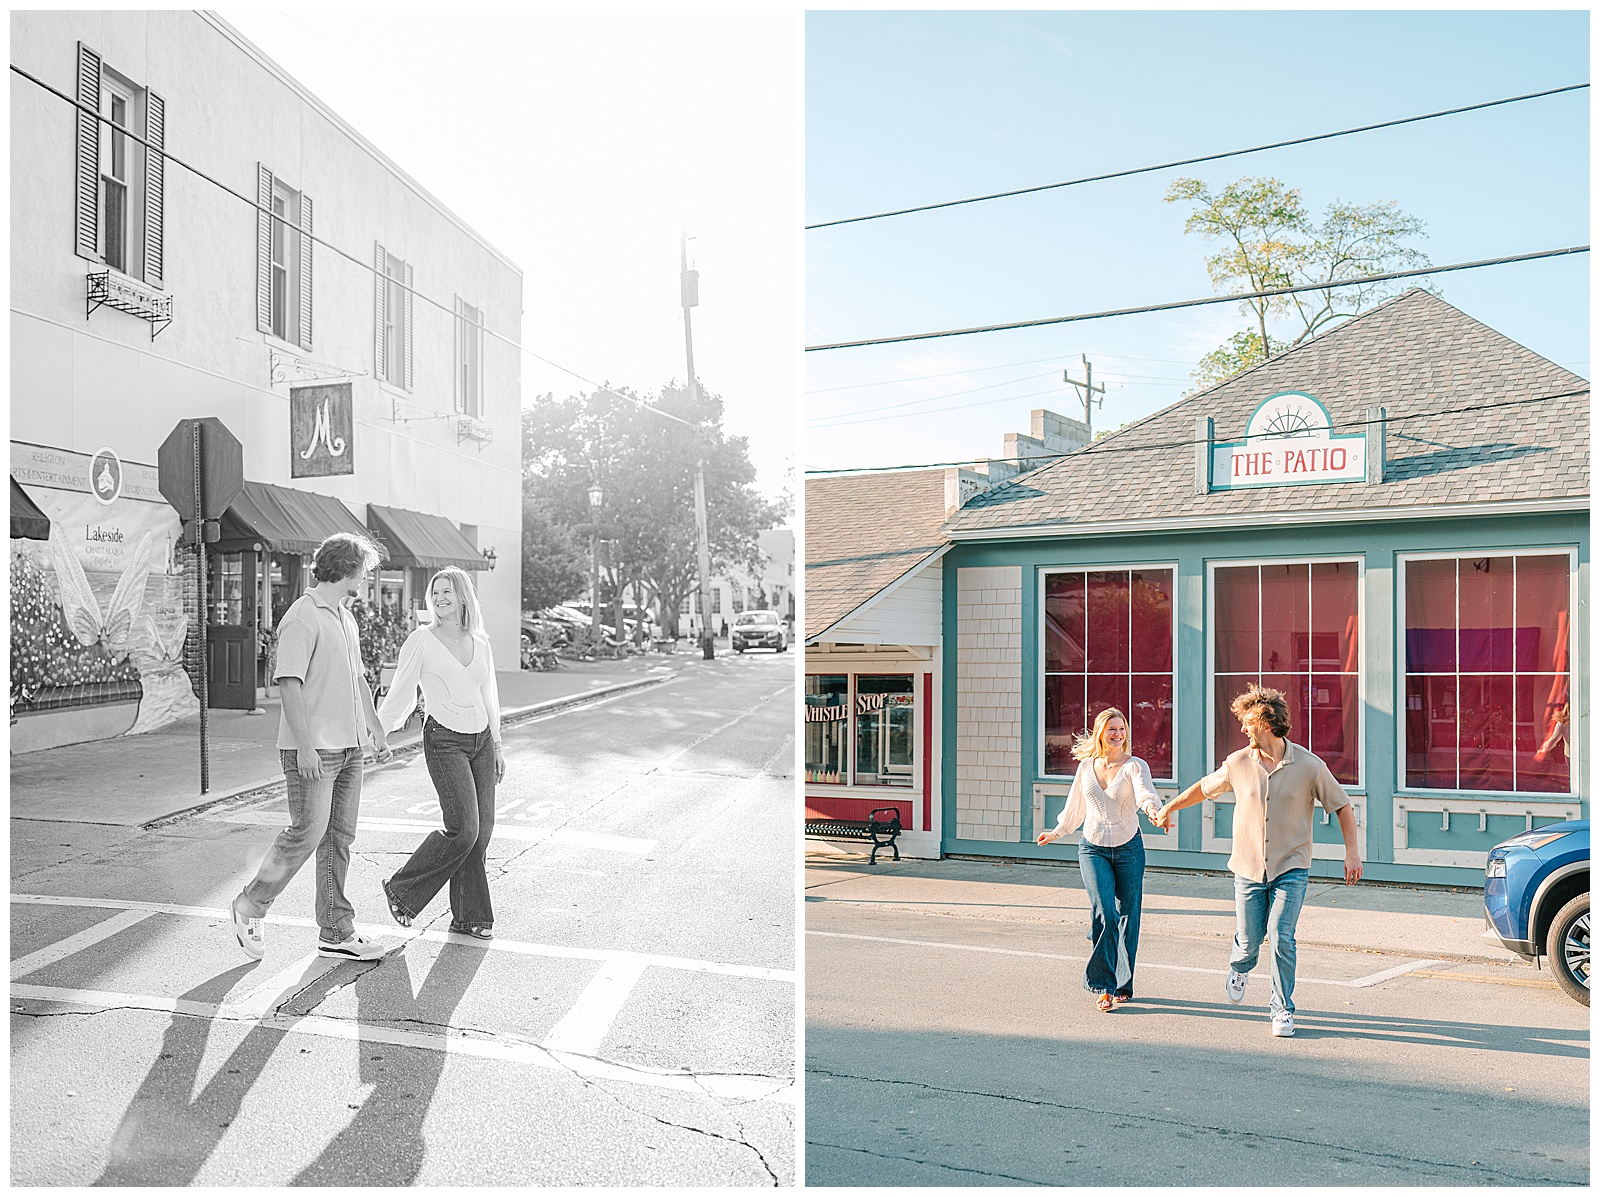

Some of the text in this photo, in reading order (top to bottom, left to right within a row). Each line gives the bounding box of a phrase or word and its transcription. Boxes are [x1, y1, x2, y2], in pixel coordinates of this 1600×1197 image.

[300, 395, 346, 460] M
[32, 452, 66, 466] RELIGION
[1231, 446, 1347, 477] THE PATIO
[85, 524, 124, 543] Lakeside
[857, 693, 888, 715] STOP
